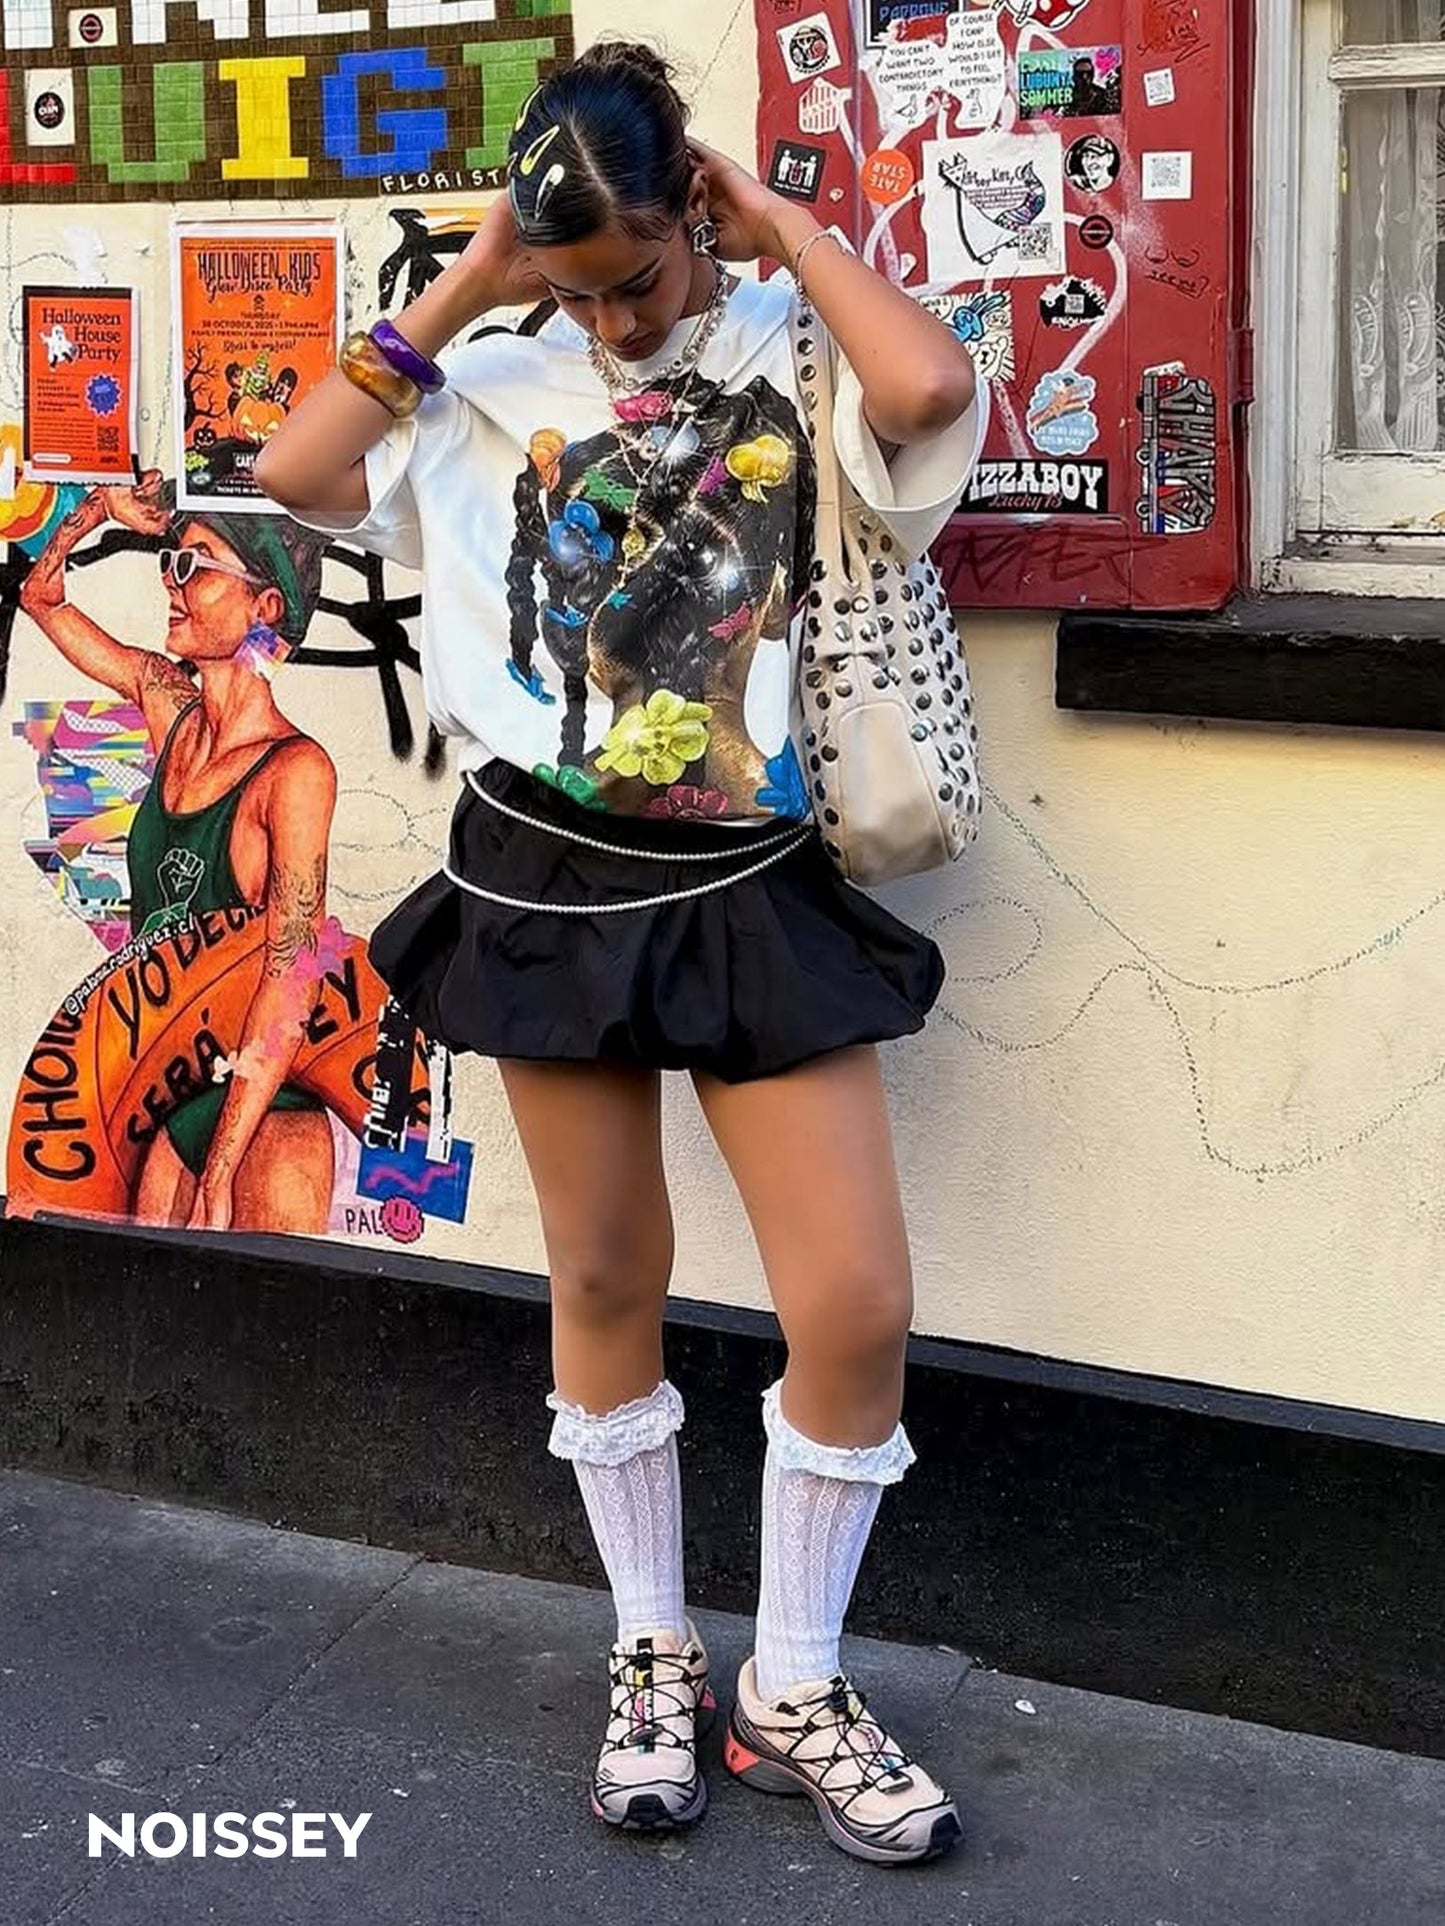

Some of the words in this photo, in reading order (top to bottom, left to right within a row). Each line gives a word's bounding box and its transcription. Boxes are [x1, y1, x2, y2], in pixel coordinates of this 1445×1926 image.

[886, 60, 911, 70] WANT
[914, 57, 935, 66] TWO
[383, 168, 500, 192] FLORIST
[872, 161, 906, 180] STAR
[869, 174, 900, 193] TATE
[198, 252, 279, 280] HALLOWEEN
[289, 252, 321, 281] KIDS
[43, 307, 121, 325] Halloween
[75, 326, 121, 343] House
[77, 344, 121, 364] Party
[969, 462, 1104, 510] IZZABOY
[108, 944, 171, 1061] YO
